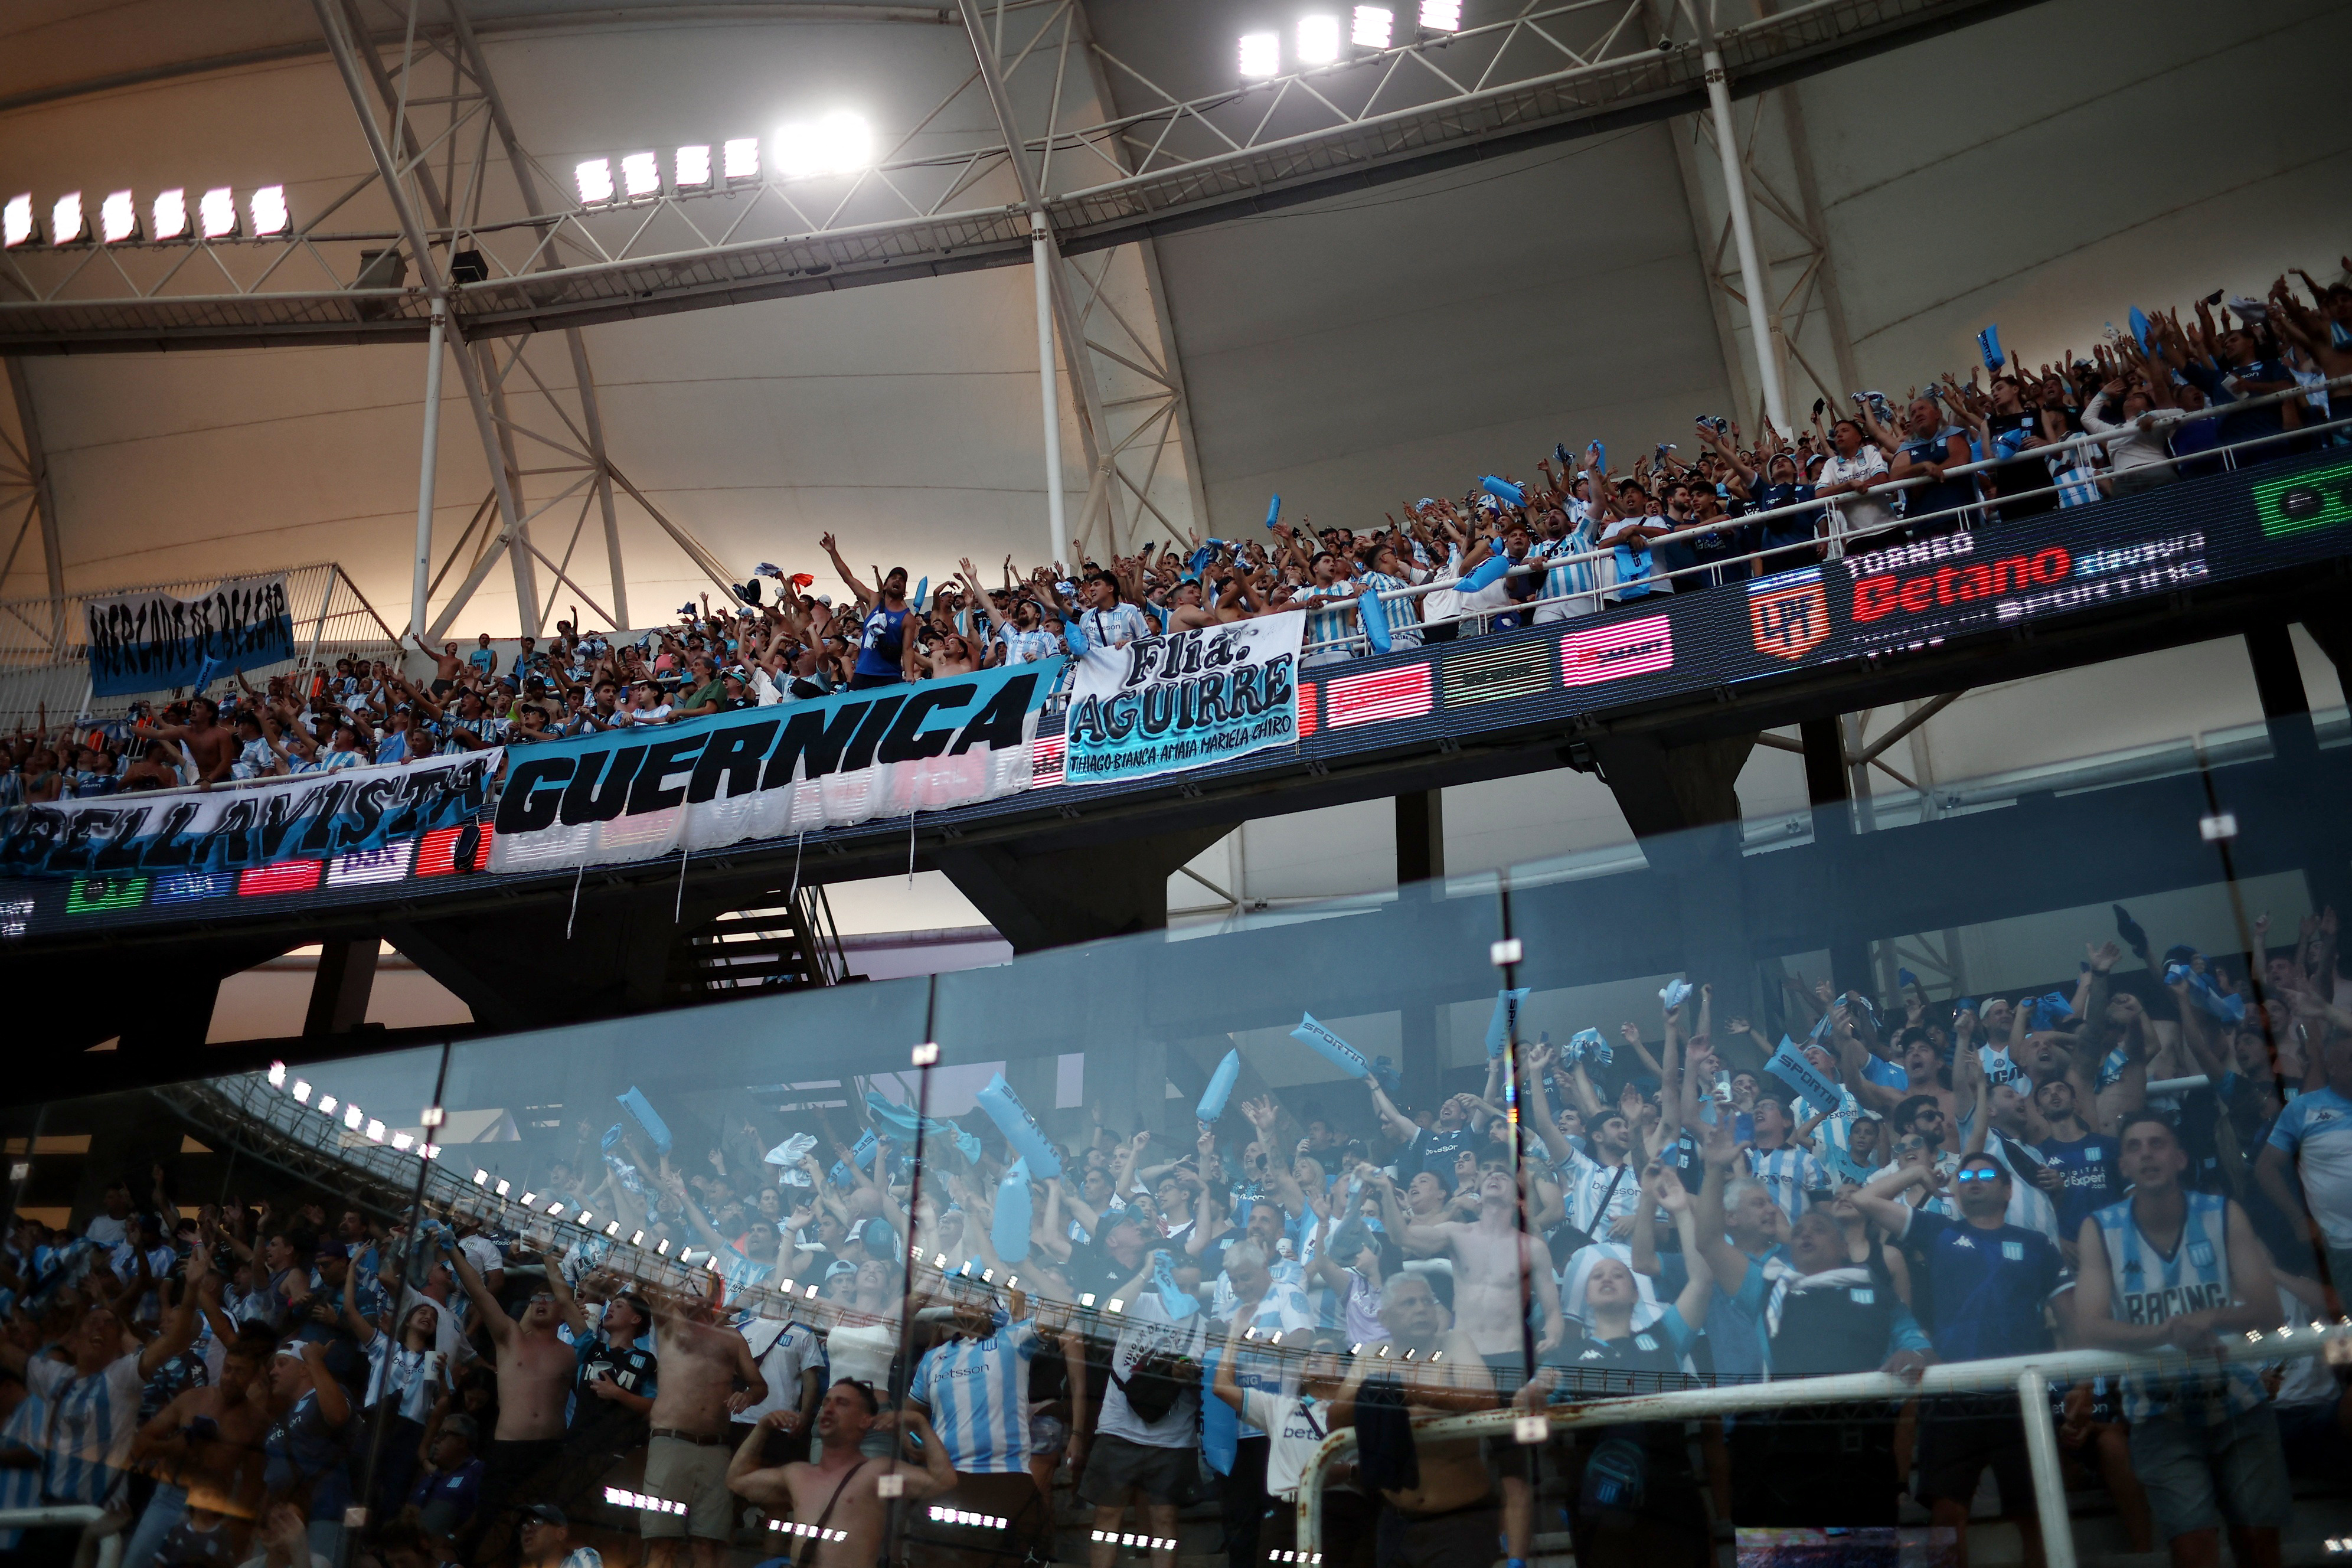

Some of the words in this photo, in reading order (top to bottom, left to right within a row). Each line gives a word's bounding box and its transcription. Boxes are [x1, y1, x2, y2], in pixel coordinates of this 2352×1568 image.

[1852, 547, 2071, 623] Betano
[90, 597, 188, 684] MERCADO
[190, 597, 215, 667] DE
[1089, 623, 1121, 632] besson
[1125, 628, 1250, 687] Flia.
[1070, 652, 1293, 743] AGUIRRE
[494, 674, 1040, 834] GUERNICA
[1303, 1022, 1366, 1067] SPORTIN
[1778, 1053, 1840, 1109] SPORTIN
[1829, 1108, 1858, 1119] Expert
[1593, 1180, 1642, 1197] besson
[2064, 1173, 2106, 1188] dExpert
[2124, 1283, 2226, 1327] RACING
[934, 1362, 990, 1383] betsson
